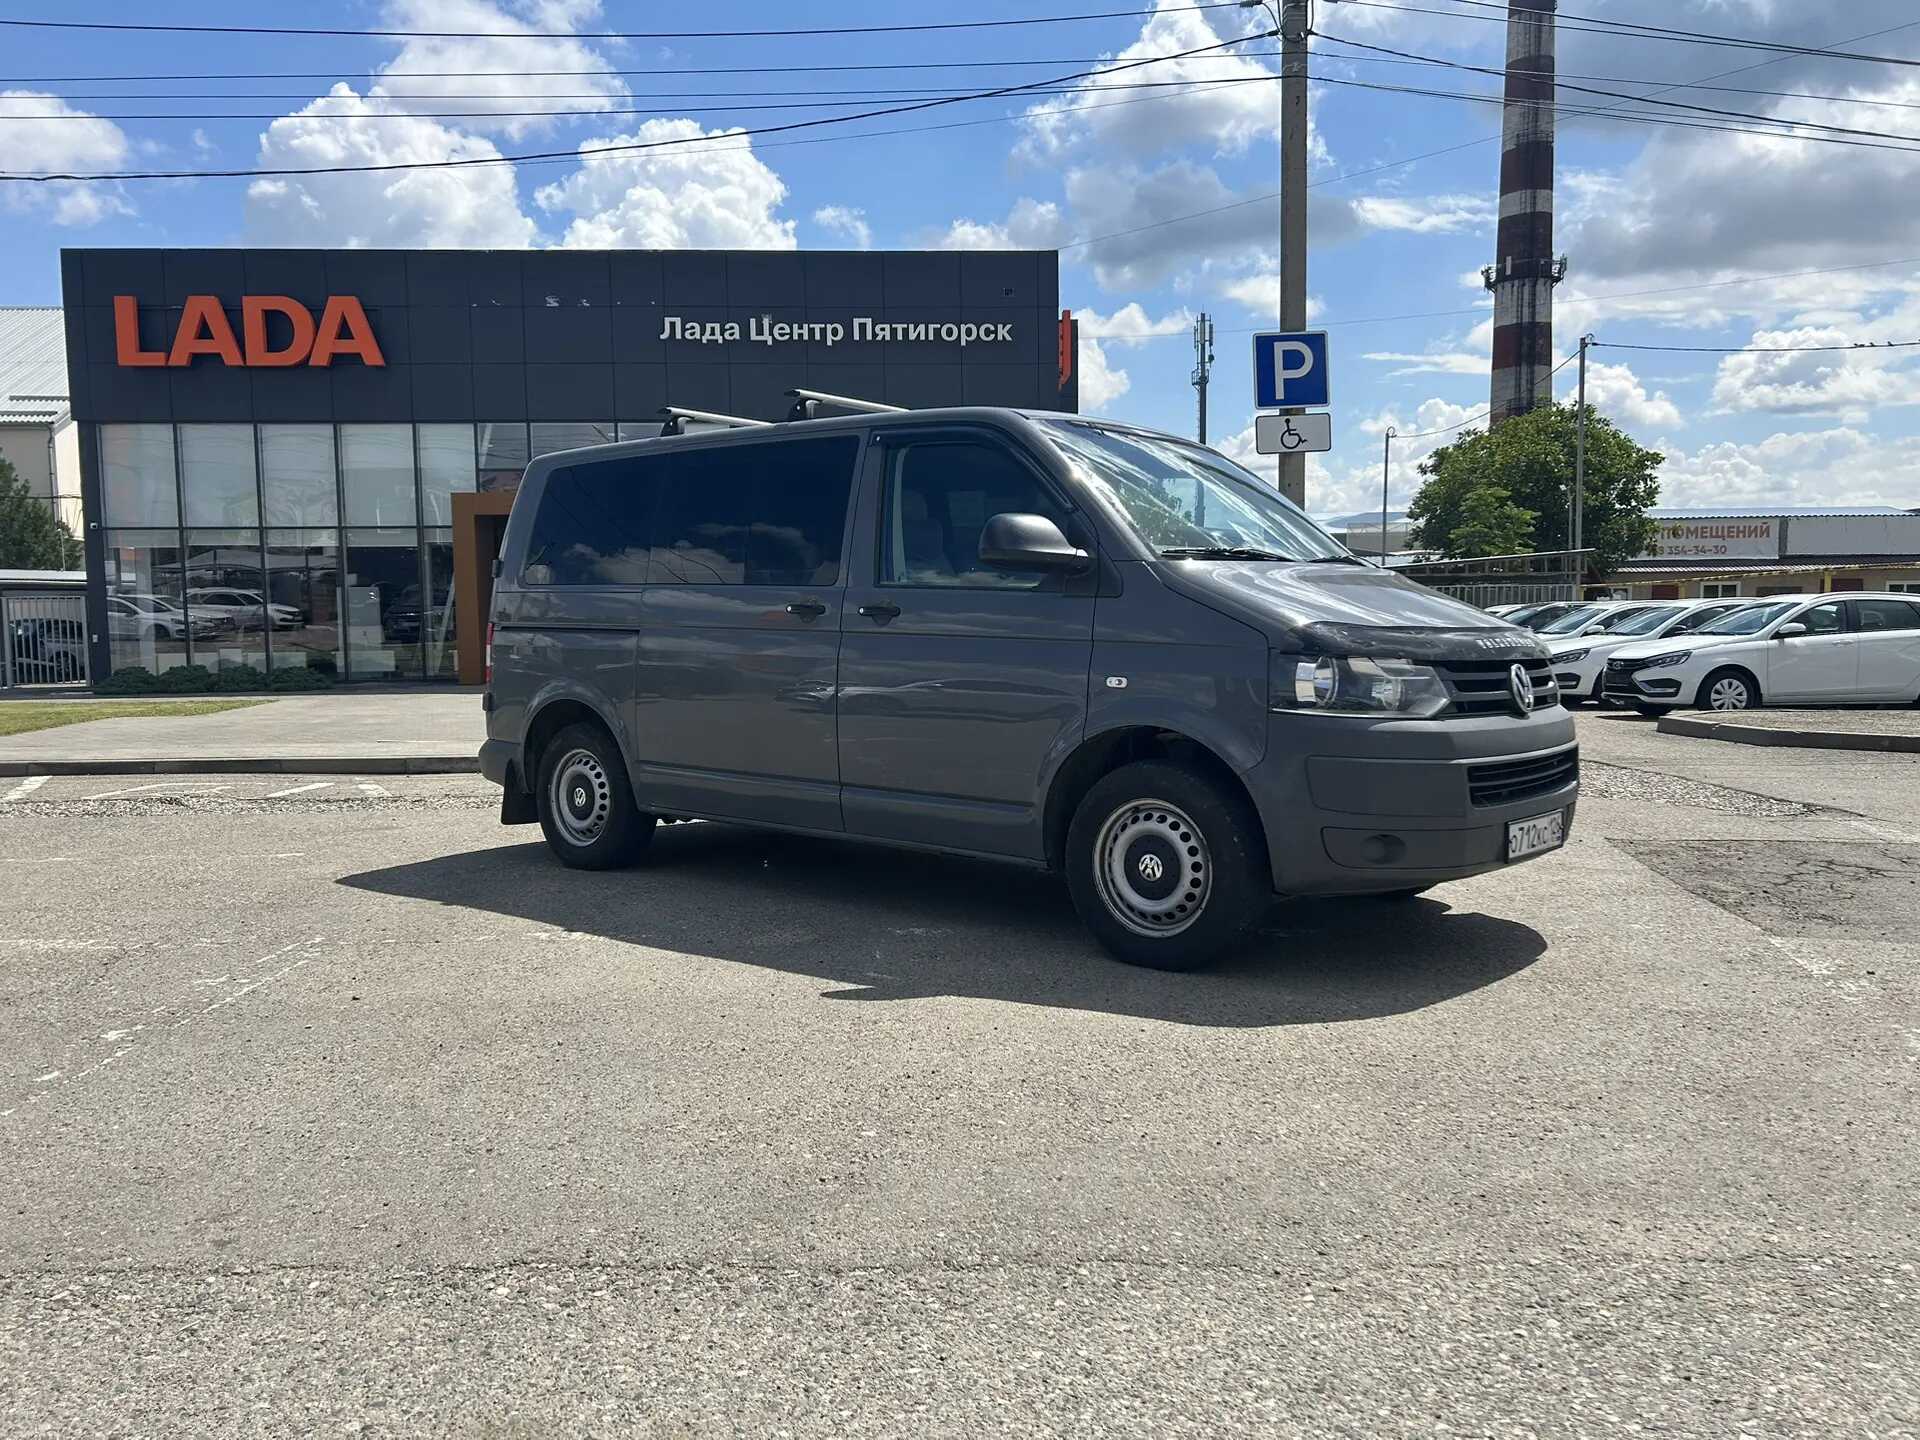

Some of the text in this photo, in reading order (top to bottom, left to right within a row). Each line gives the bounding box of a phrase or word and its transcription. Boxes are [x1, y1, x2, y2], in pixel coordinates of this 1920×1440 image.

[113, 295, 386, 367] LADA
[659, 316, 1013, 346] Лада Центр Пятигорск
[1273, 341, 1314, 400] P
